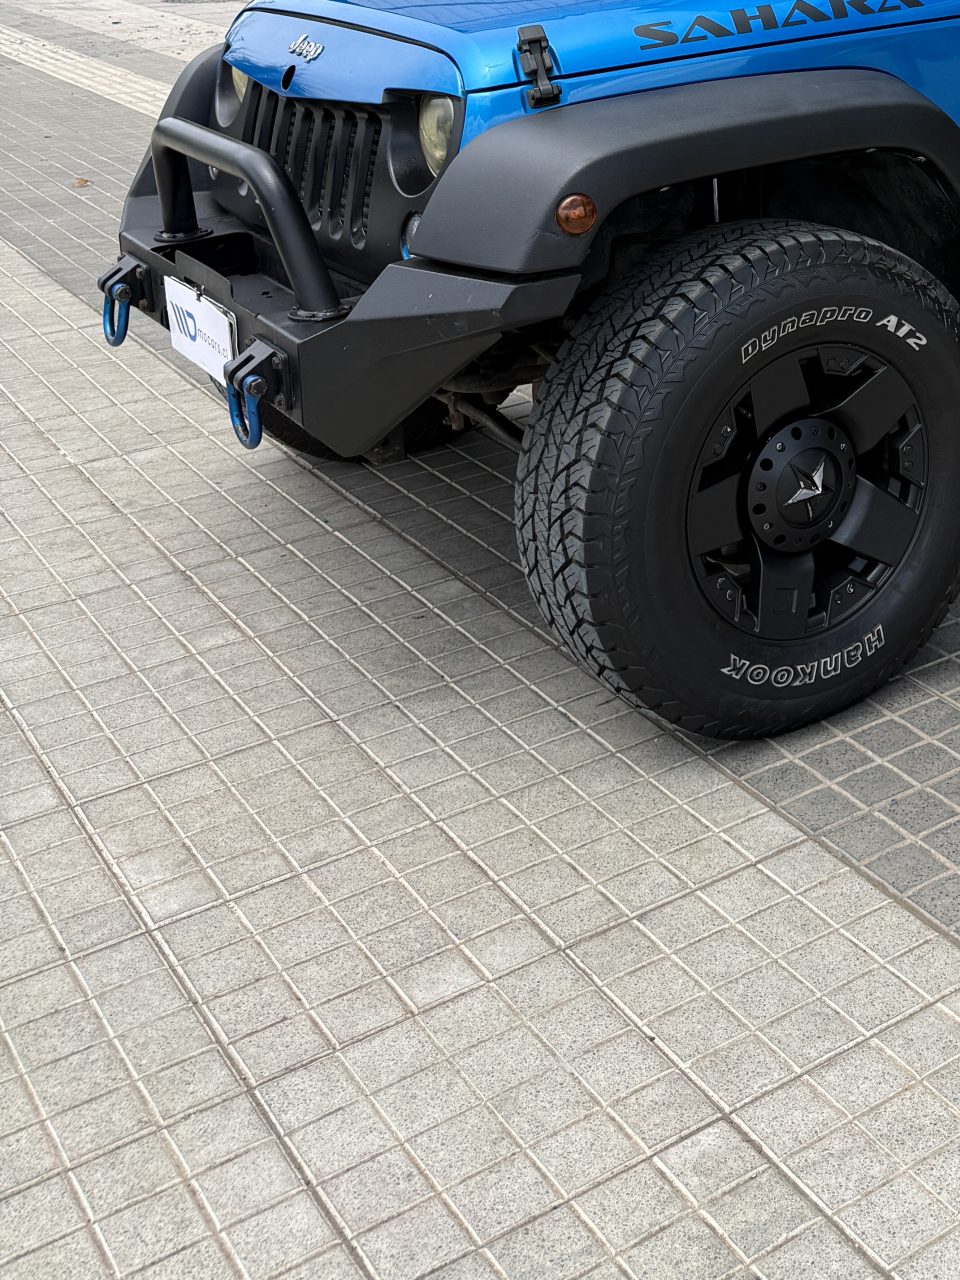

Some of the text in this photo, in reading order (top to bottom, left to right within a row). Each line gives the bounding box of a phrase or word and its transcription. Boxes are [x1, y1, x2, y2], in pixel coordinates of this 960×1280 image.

[288, 33, 325, 64] Jeep
[741, 306, 928, 364] Dynapro AT2
